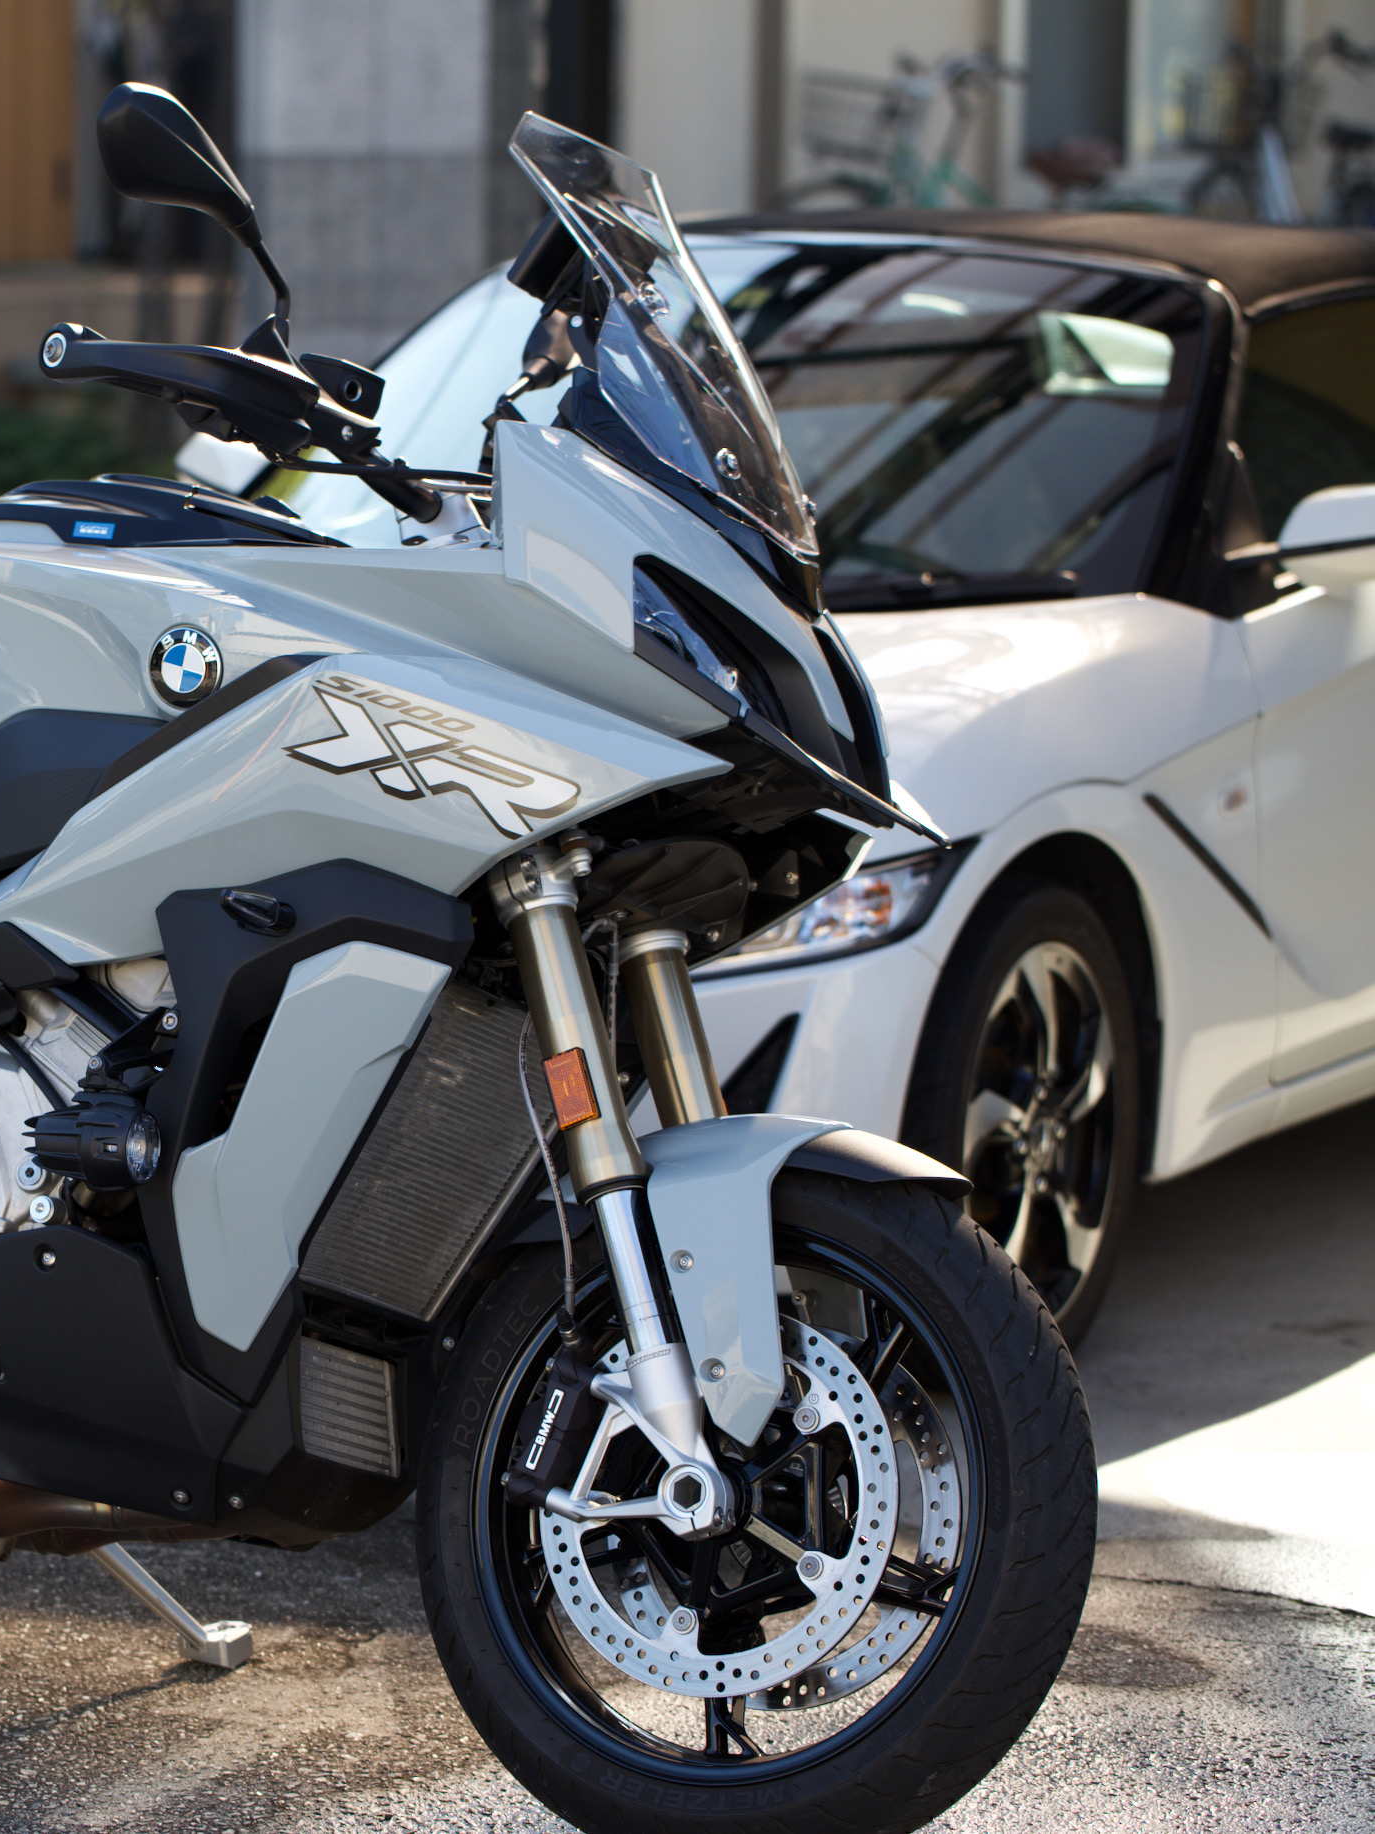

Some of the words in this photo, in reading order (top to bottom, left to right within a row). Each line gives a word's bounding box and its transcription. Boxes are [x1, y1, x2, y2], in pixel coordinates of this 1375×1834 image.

[161, 630, 218, 663] BMW
[280, 684, 581, 841] XR
[886, 1254, 955, 1324] 120/70
[452, 1292, 541, 1450] ROADTEC
[534, 1409, 556, 1446] BMW
[599, 1767, 785, 1811] METZELER
